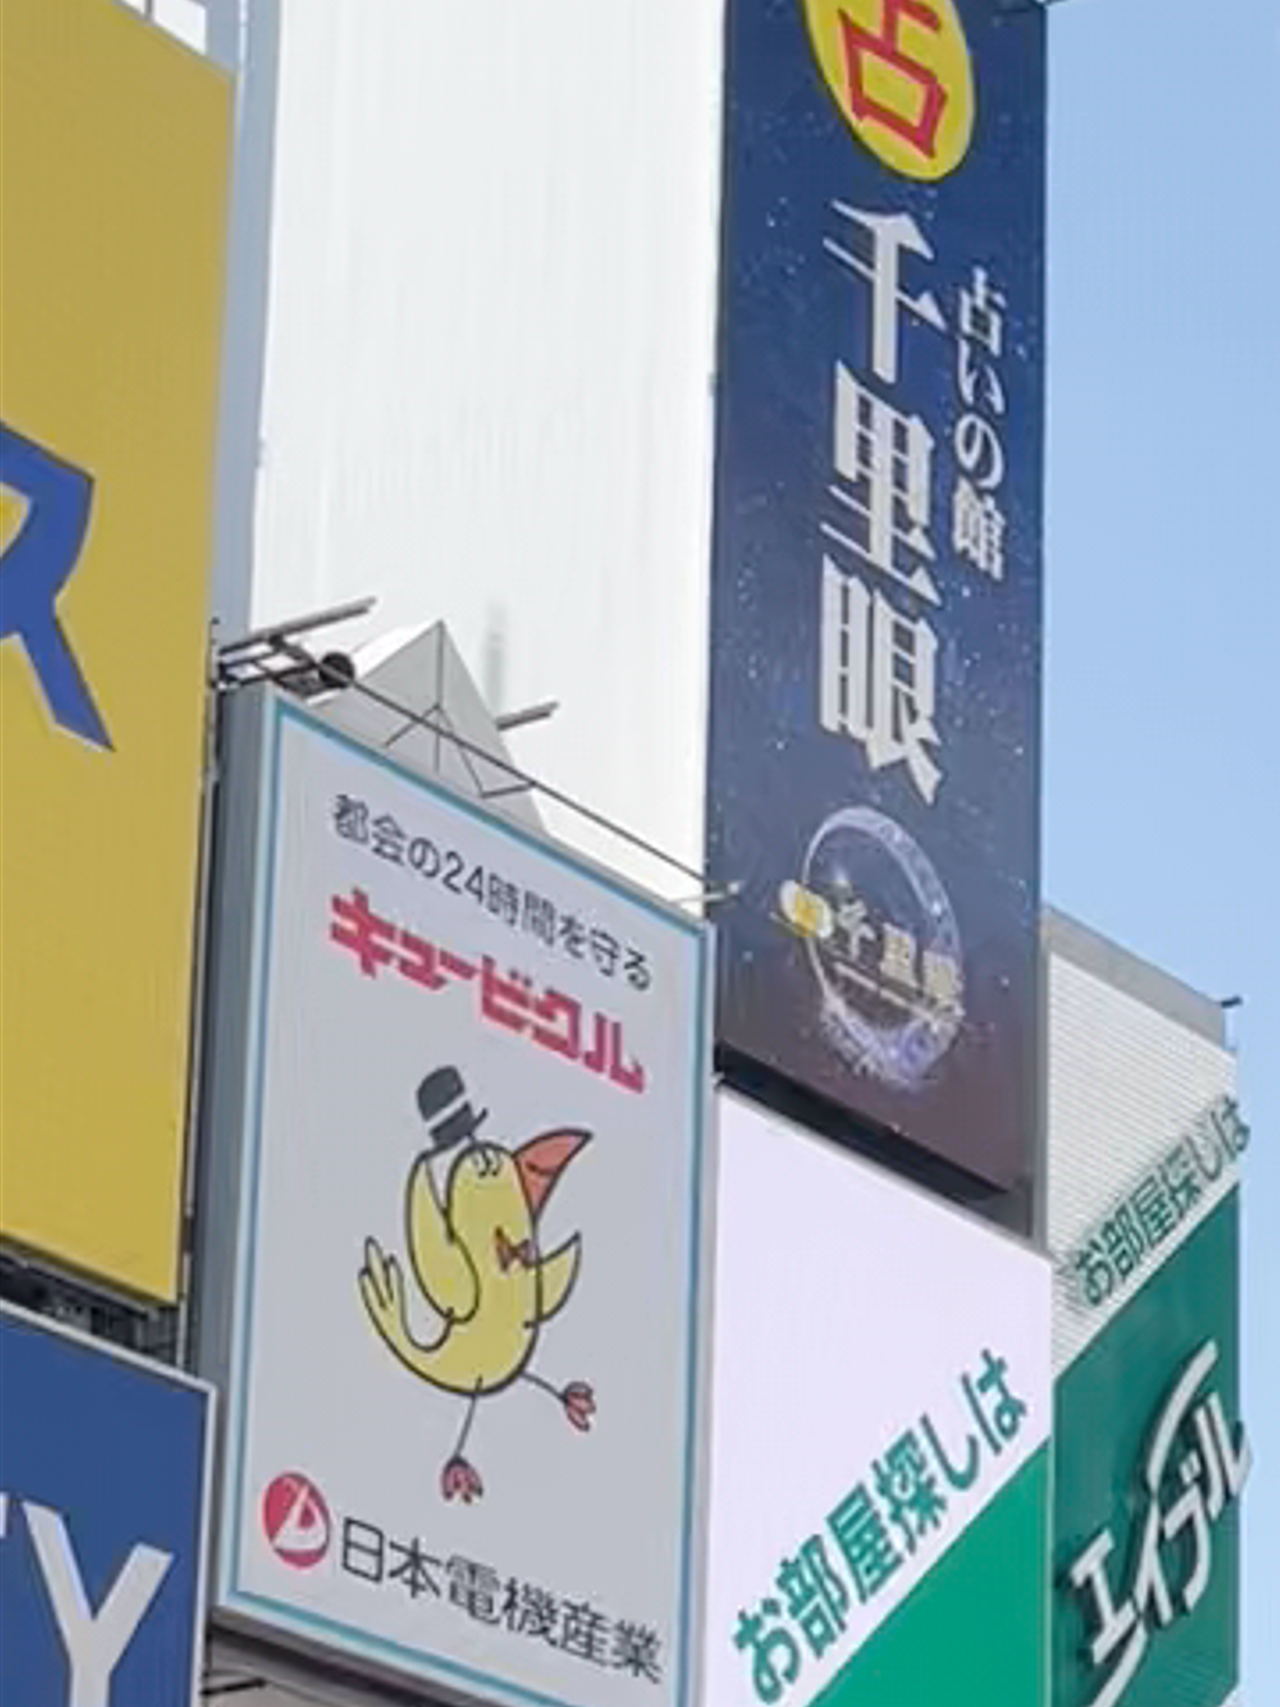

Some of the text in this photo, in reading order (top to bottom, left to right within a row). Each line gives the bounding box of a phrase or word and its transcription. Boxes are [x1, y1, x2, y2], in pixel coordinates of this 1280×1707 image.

[822, 197, 946, 805] 千里眼
[950, 265, 1008, 583] 占いの館
[328, 885, 646, 1096] キュービクル
[330, 793, 652, 994] 都会の24時間を守る
[1072, 1093, 1250, 1309] お部屋探しは
[340, 1513, 664, 1685] 日本電機産業
[731, 1346, 1030, 1707] お部屋探しは
